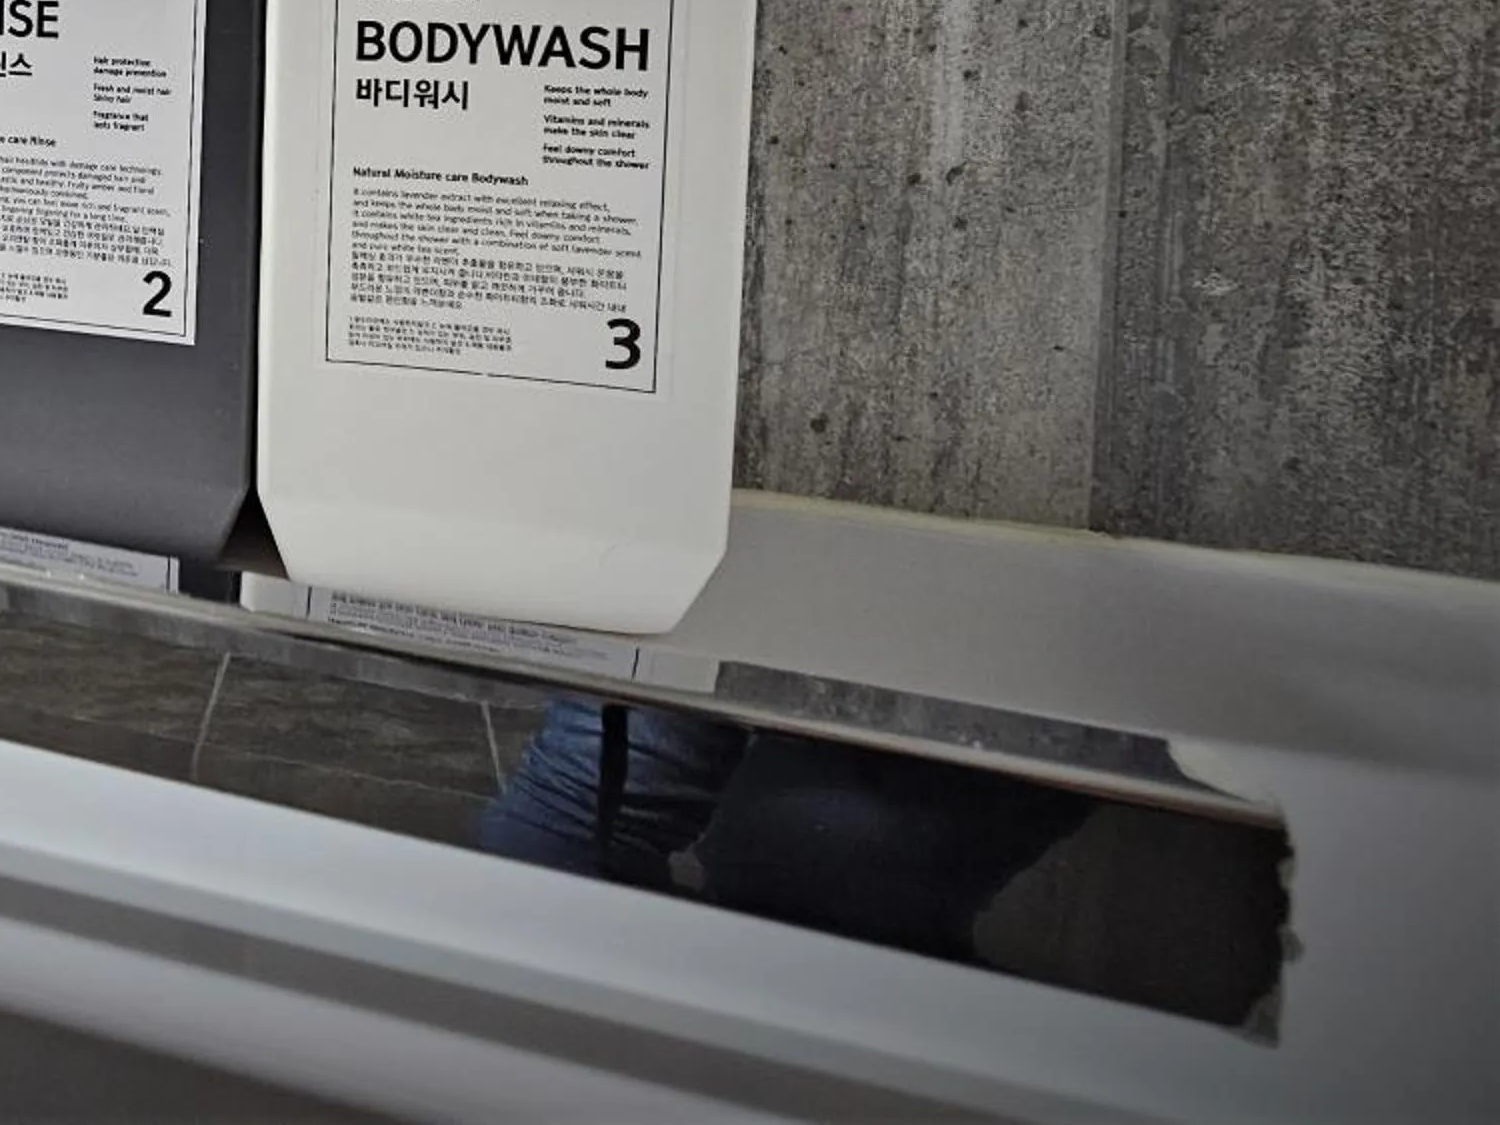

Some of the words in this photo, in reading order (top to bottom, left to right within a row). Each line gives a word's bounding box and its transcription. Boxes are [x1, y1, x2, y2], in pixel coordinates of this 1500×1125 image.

[356, 20, 650, 72] BODYWASH
[356, 78, 469, 110] 바디워시
[544, 84, 572, 94] Keeps
[575, 86, 590, 94] the
[593, 87, 621, 96] whole
[624, 89, 648, 99] body
[543, 94, 569, 104] moist
[572, 96, 590, 105] and
[593, 97, 610, 106] soft
[543, 114, 584, 124] Vitamins
[587, 117, 604, 126] and
[607, 118, 649, 128] minerals
[543, 126, 568, 134] make
[571, 127, 586, 135] the
[589, 129, 608, 137] skin
[611, 130, 634, 138] clear
[543, 143, 562, 152] Feel
[565, 145, 594, 155] downy
[597, 147, 635, 157] comfort
[542, 155, 593, 167] throughout
[596, 158, 611, 167] the
[615, 160, 649, 169] shower
[353, 166, 390, 177] Natural
[394, 168, 441, 180] Moisture
[445, 173, 468, 182] care
[471, 173, 528, 187] Bodywash
[142, 270, 173, 317] 2
[605, 318, 641, 370] 3
